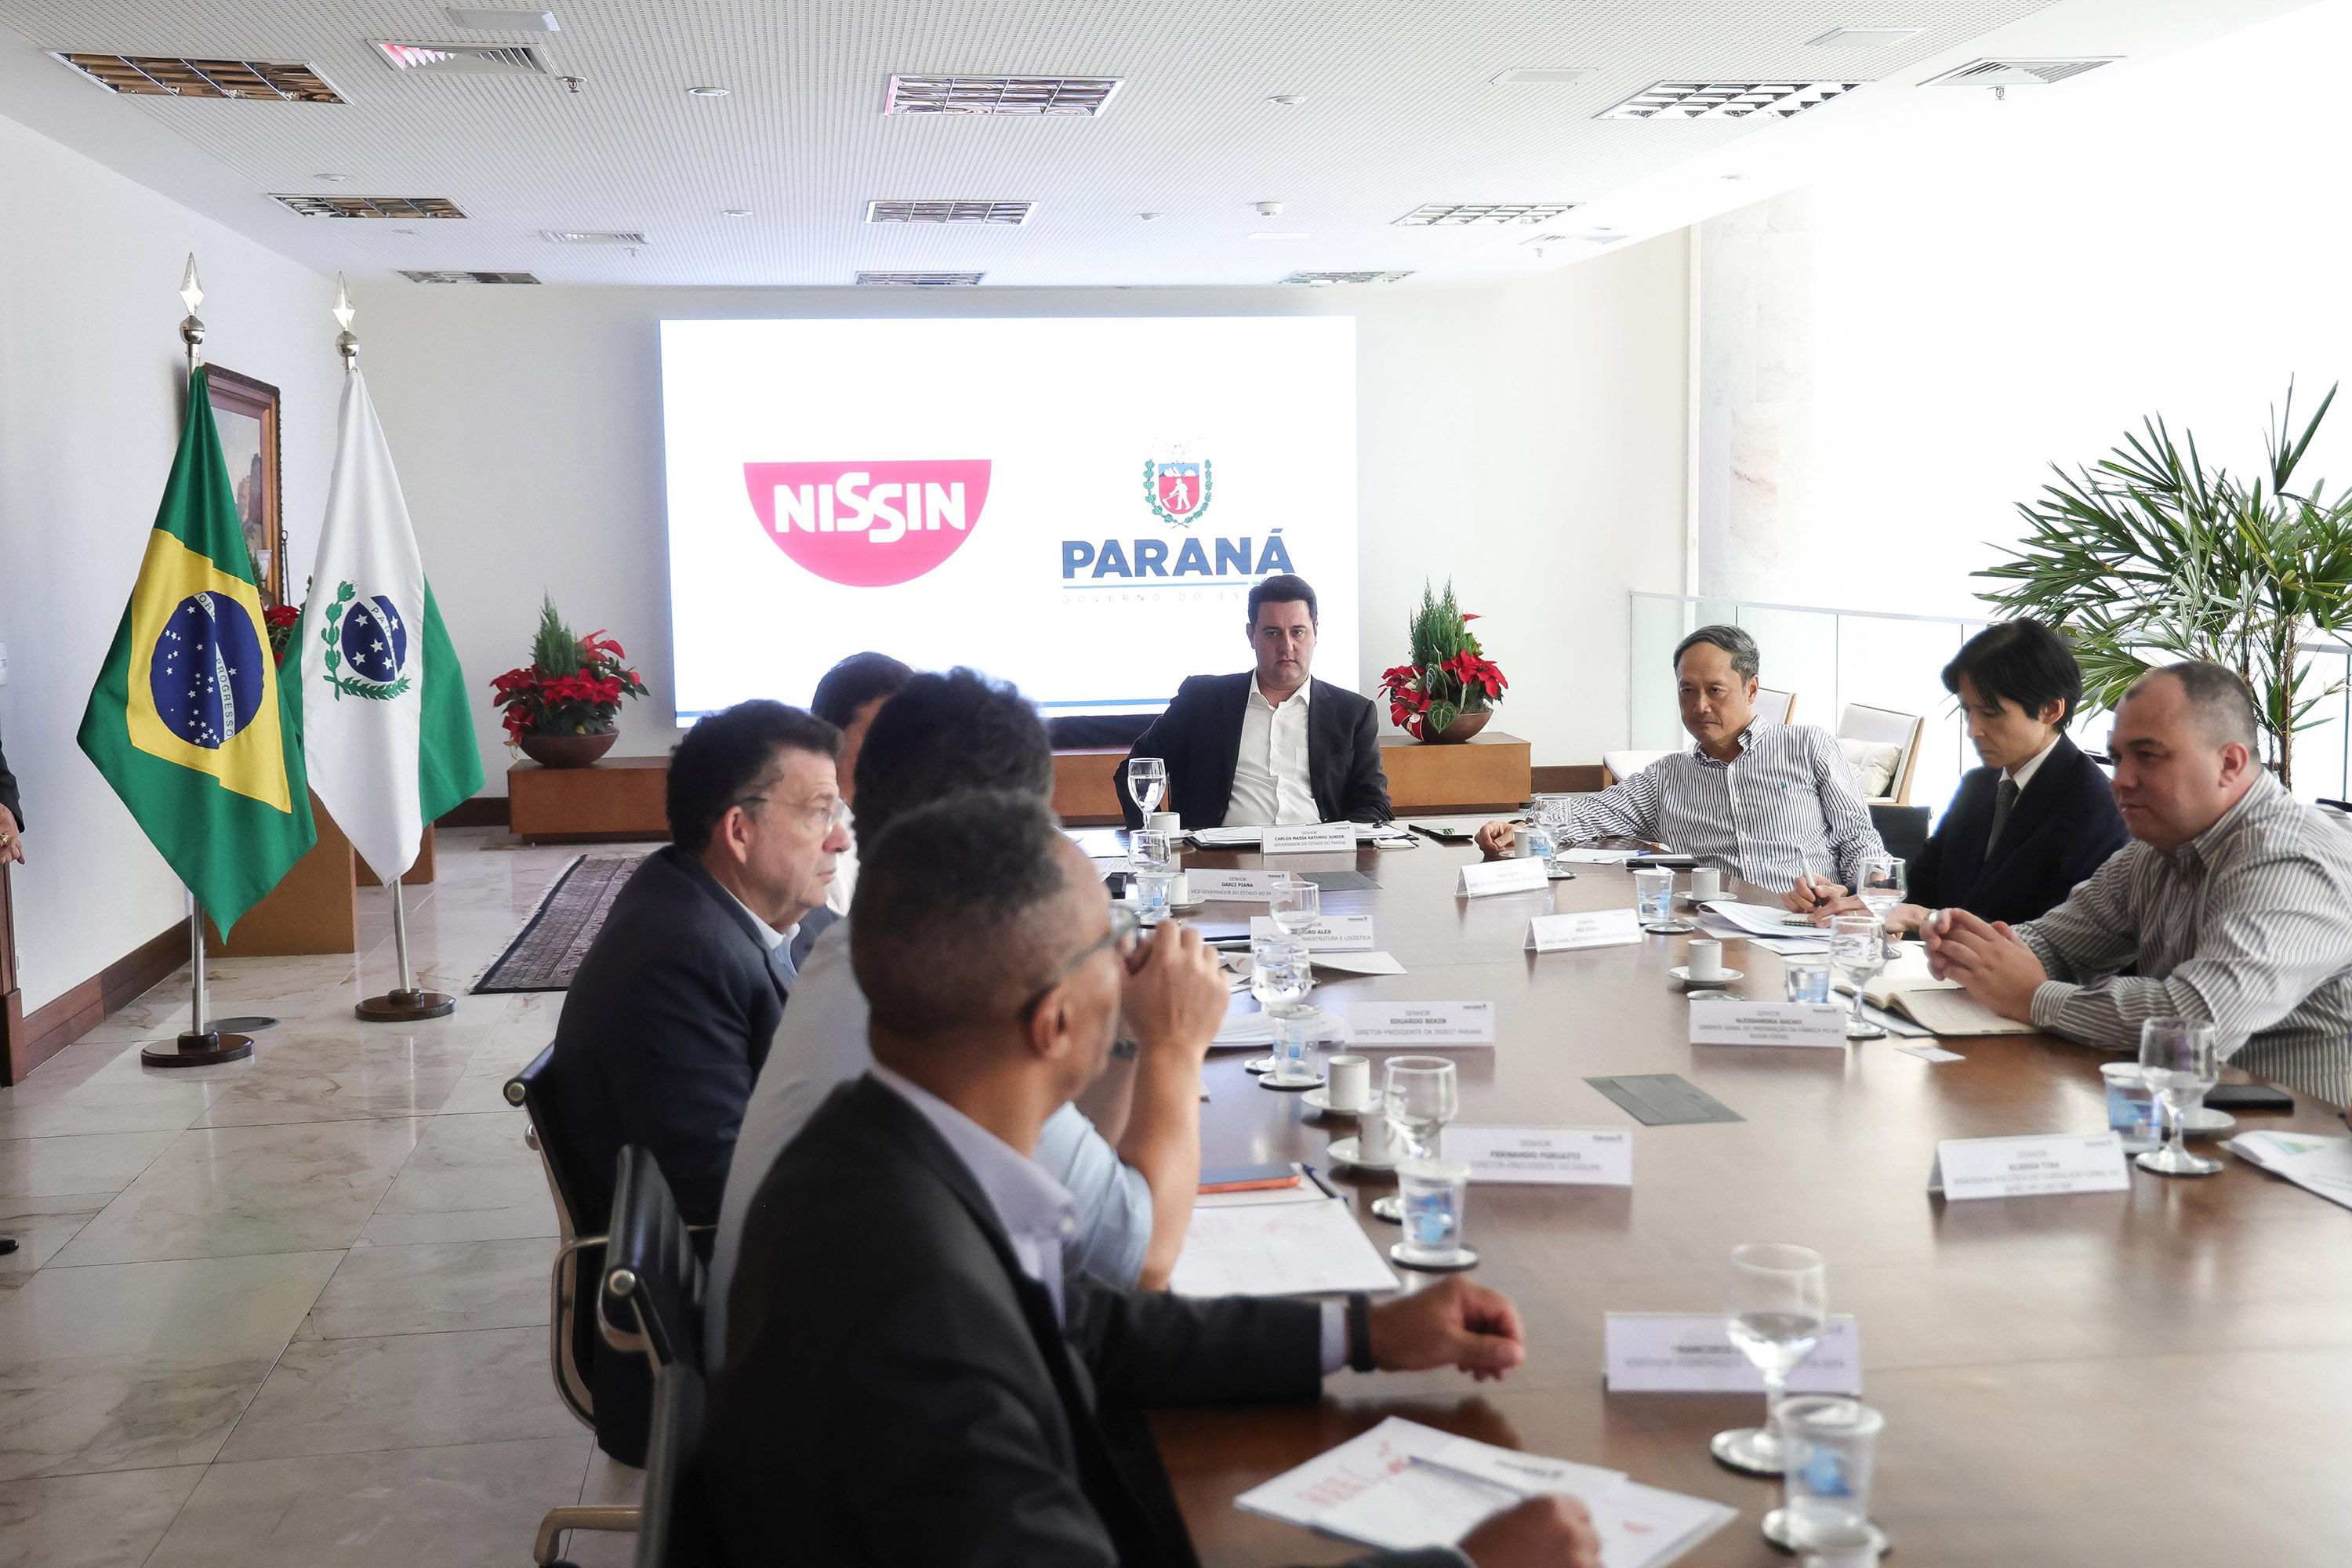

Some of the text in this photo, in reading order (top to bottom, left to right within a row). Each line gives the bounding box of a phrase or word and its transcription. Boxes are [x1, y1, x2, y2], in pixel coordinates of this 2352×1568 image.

[775, 472, 966, 543] NISSIN
[1062, 528, 1296, 579] PARANÁ
[1063, 593, 1160, 603] GOVERNO
[1178, 593, 1201, 601] DO
[216, 659, 234, 737] PROGRESSO
